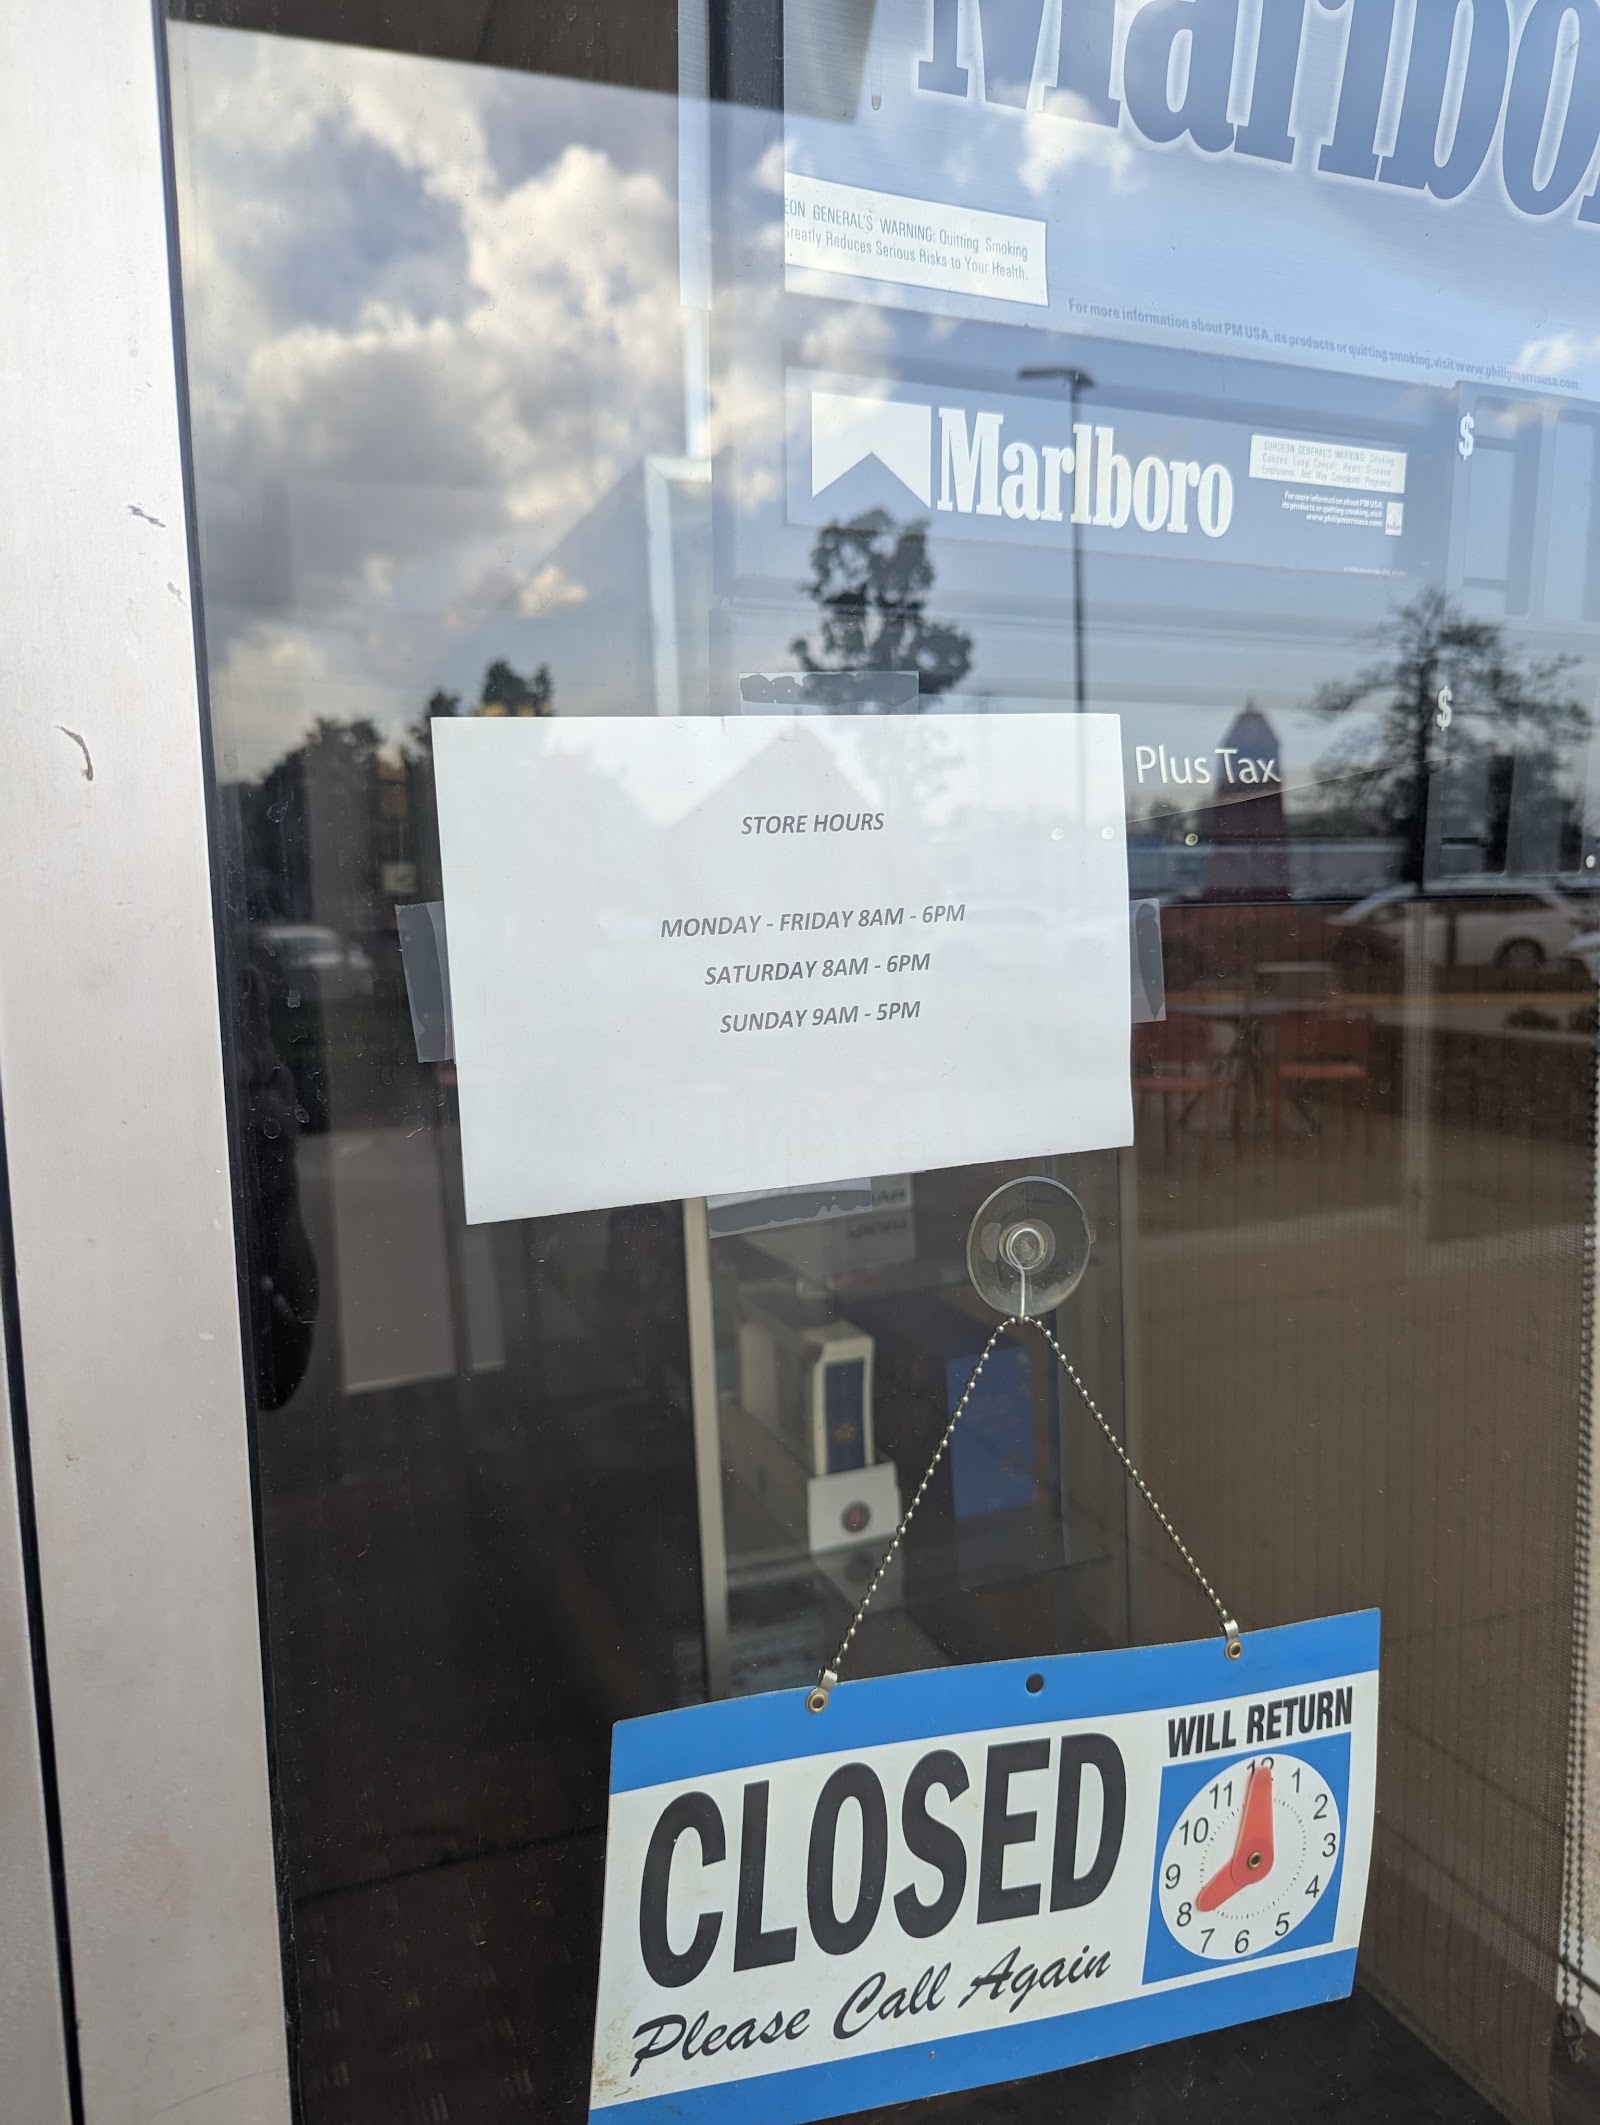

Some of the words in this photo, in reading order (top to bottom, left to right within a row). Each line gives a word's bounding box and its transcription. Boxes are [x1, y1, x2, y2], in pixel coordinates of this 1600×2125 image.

[918, 0, 1600, 224] Marlbo
[813, 205, 874, 231] GENERAL'S
[880, 218, 936, 243] WARNING:
[939, 230, 979, 253] Quitting
[985, 238, 1028, 262] Smoking
[826, 231, 872, 254] Reduces
[876, 241, 915, 262] Serious
[919, 249, 947, 267] Risks
[951, 257, 961, 270] to
[964, 257, 988, 275] Your
[992, 261, 1028, 281] Health.
[1068, 298, 1088, 314] For
[1090, 306, 1120, 320] more
[1122, 307, 1189, 329] information
[1191, 318, 1223, 334] about
[1224, 323, 1243, 337] PM
[1245, 326, 1272, 343] USA,
[1274, 330, 1287, 344] its
[1289, 333, 1335, 352] products
[1337, 343, 1346, 353] or
[1349, 343, 1388, 362] quitting
[1389, 351, 1434, 370] smoking,
[1434, 357, 1454, 370] visit
[1263, 441, 1295, 453] SURGEON
[1458, 412, 1475, 460] $
[937, 407, 1233, 537] Marlboro
[1284, 491, 1294, 500] For
[1436, 686, 1452, 732] $
[1135, 745, 1211, 784] Plus
[1214, 749, 1282, 784] Tax
[741, 815, 808, 835] STORE
[813, 812, 885, 833] HOURS
[660, 914, 762, 938] MONDAY
[779, 910, 854, 932] FRIDAY
[857, 907, 905, 928] 8AM
[922, 904, 966, 924] 6PM
[704, 960, 818, 986] SATURDAY
[822, 957, 869, 978] 8AM
[886, 953, 931, 973] 6PM
[720, 1009, 807, 1034] SUNDAY
[811, 1005, 859, 1027] 9AM
[876, 1001, 921, 1021] 5PM
[1167, 1709, 1237, 1759] WILL
[1246, 1685, 1353, 1744] RETURN
[1209, 1781, 1233, 1810] 11
[1291, 1767, 1302, 1793] 1
[1313, 1793, 1328, 1820] 2
[1179, 1816, 1209, 1846] 10
[1322, 1832, 1337, 1858] 3
[638, 1732, 1128, 1989] CLOSED
[1165, 1863, 1181, 1889] 9
[1305, 1874, 1320, 1899] 4
[1176, 1901, 1192, 1927] 8
[1274, 1912, 1290, 1937] 5
[1200, 1928, 1215, 1954] 7
[1234, 1929, 1250, 1954] 6
[628, 2008, 811, 2079] Please
[832, 1961, 952, 2041] Call
[956, 1945, 1114, 2014] Again
